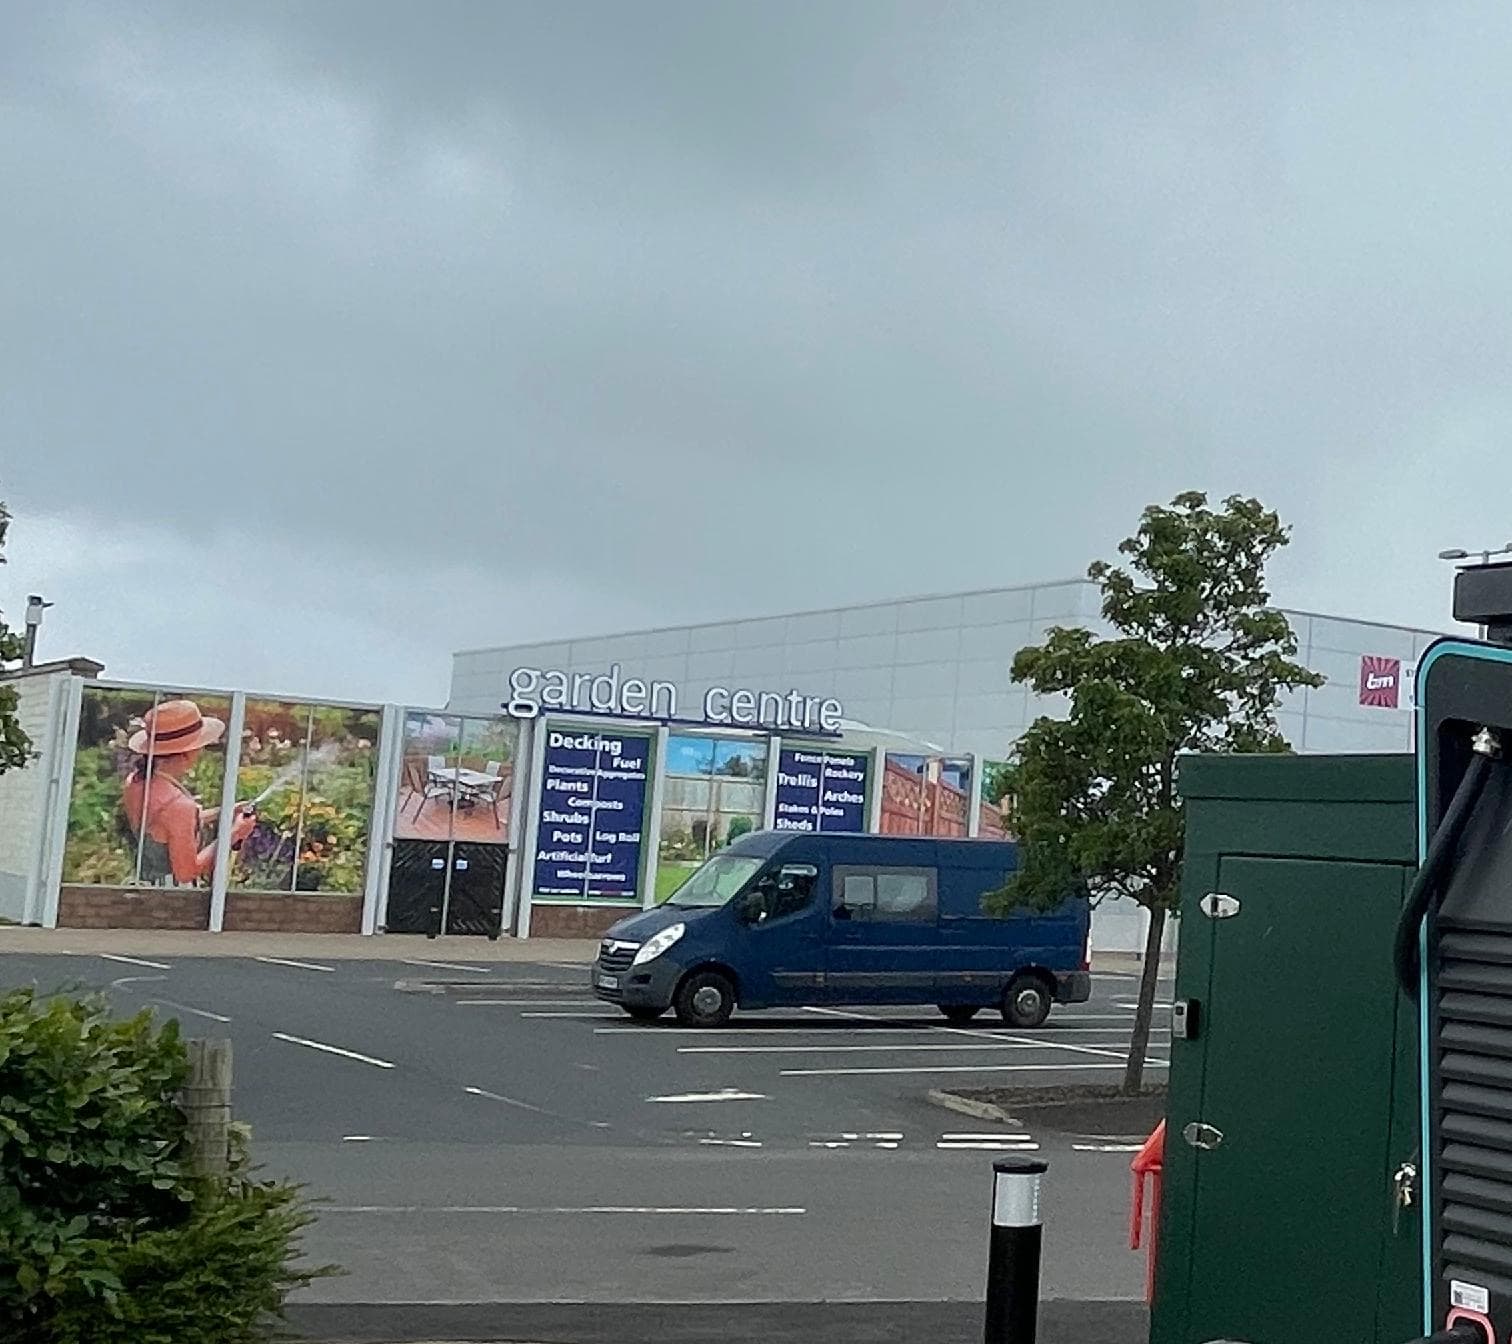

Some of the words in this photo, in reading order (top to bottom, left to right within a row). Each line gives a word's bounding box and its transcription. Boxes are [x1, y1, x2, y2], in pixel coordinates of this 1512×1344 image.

[508, 663, 678, 718] garden
[704, 686, 842, 730] centre
[549, 732, 622, 755] Decking
[612, 757, 642, 769] Fuel
[546, 778, 588, 791] Plants
[778, 773, 817, 787] Trellis
[824, 791, 863, 803] Arches
[542, 810, 590, 825] Shrubs
[776, 817, 813, 831] Sheds
[552, 830, 583, 843] Pots
